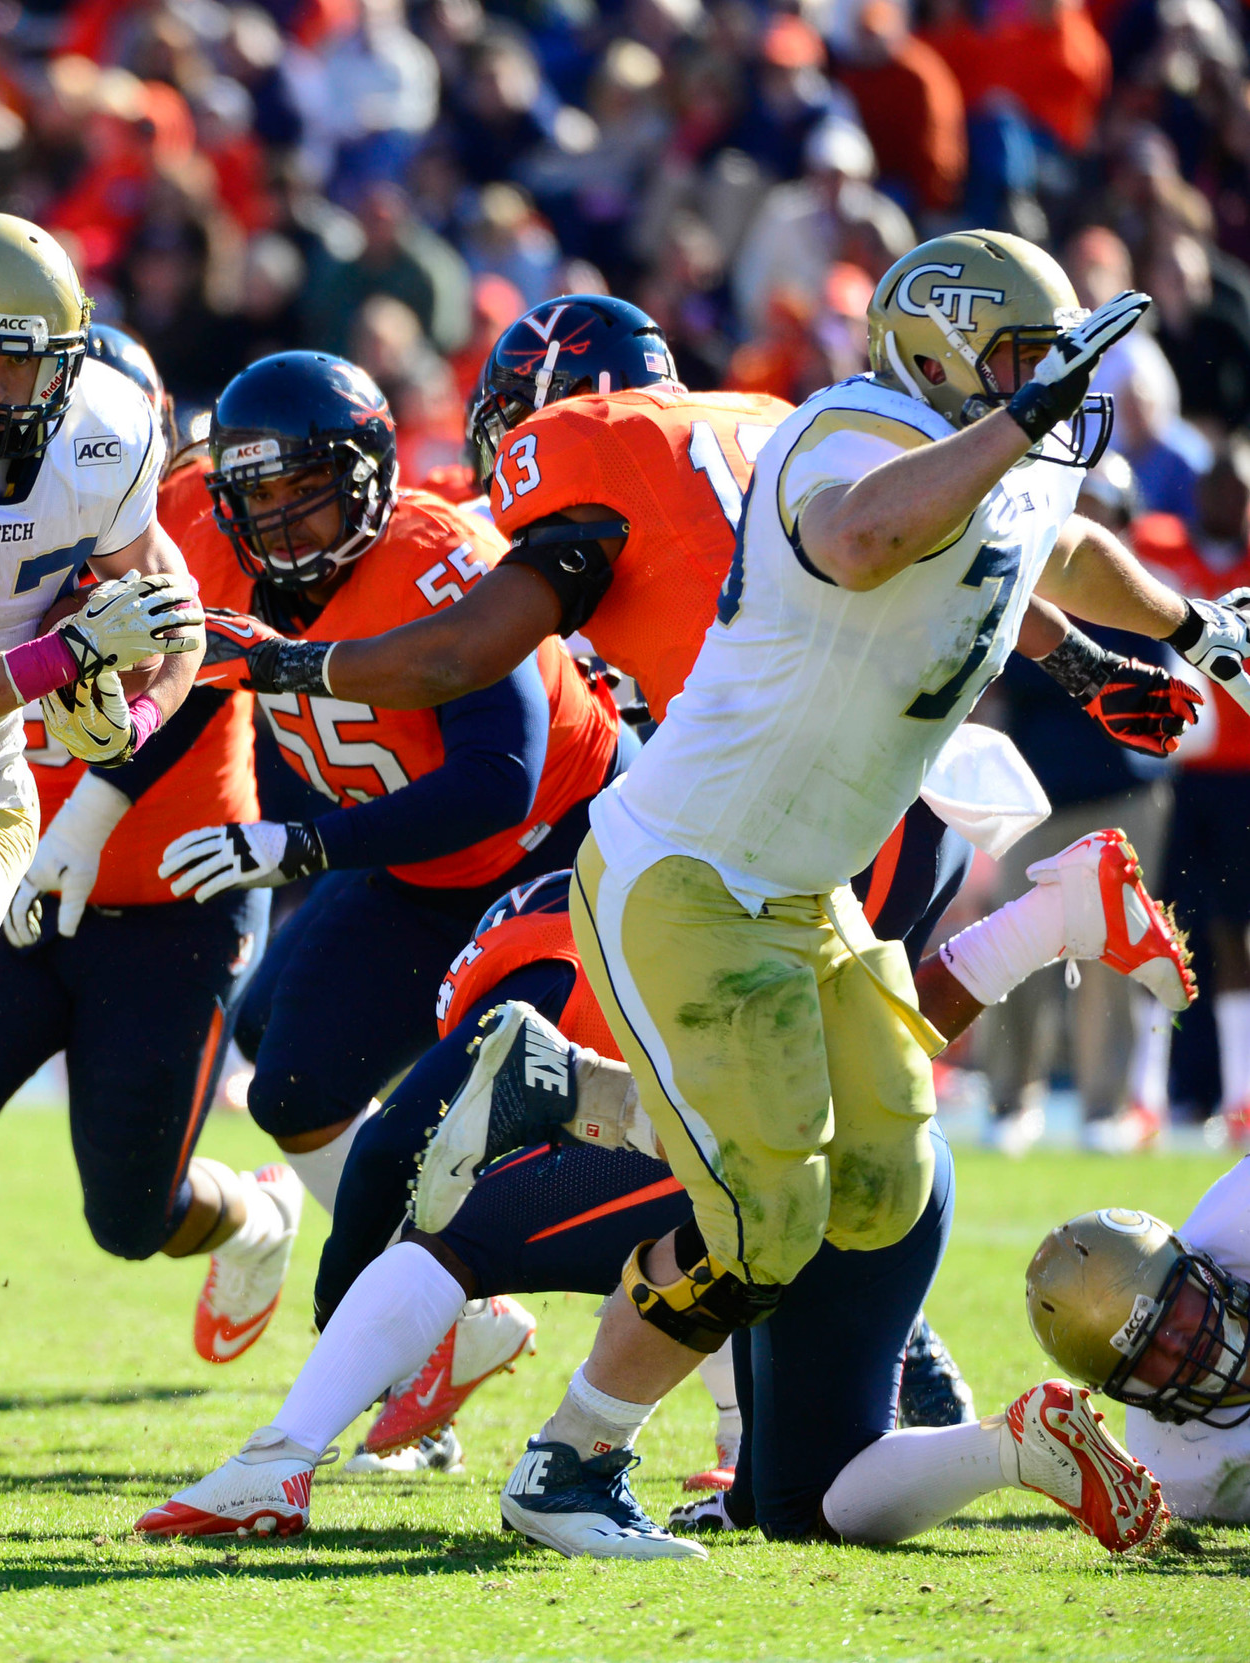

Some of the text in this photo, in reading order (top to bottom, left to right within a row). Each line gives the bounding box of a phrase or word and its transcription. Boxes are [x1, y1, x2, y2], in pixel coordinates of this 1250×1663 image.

[897, 263, 1006, 332] GT
[40, 364, 73, 400] Ridde
[78, 441, 119, 460] ACC
[236, 444, 261, 459] ACC
[494, 433, 542, 512] 13
[414, 541, 492, 608] 55
[257, 691, 412, 804] 55
[1123, 1310, 1144, 1340] ACC
[281, 1469, 316, 1510] NIK
